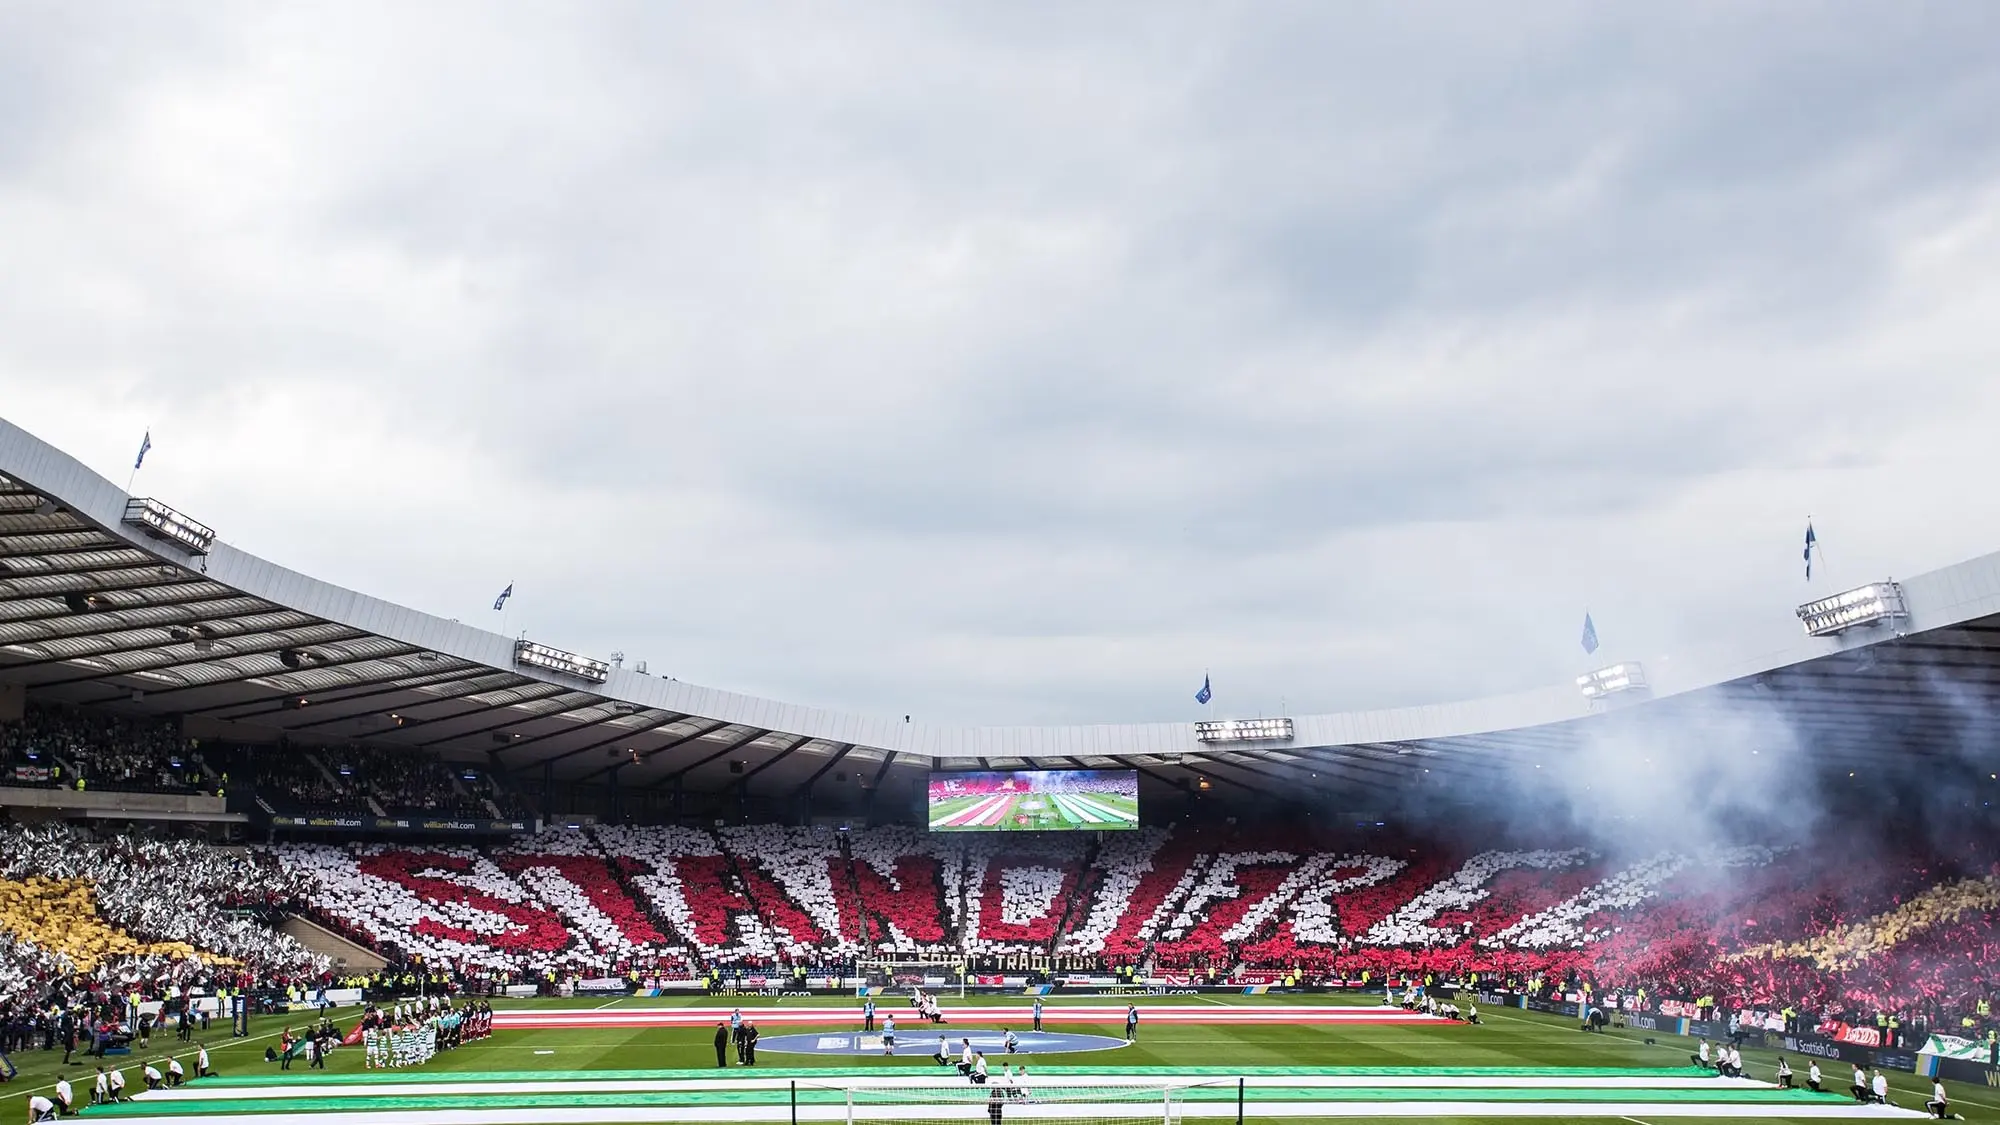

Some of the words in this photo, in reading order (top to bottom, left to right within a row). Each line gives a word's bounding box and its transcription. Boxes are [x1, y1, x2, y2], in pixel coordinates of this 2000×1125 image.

[310, 818, 361, 827] williamhill.com
[424, 821, 475, 830] williamhill.com
[995, 953, 1097, 971] TRADITION
[1235, 976, 1265, 985] ALFORD
[710, 988, 811, 996] williamhill.com
[1099, 986, 1198, 995] williamhill.com
[1453, 991, 1504, 1006] williamhill.com
[1799, 1039, 1825, 1056] Scottish
[1826, 1044, 1840, 1058] Cup
